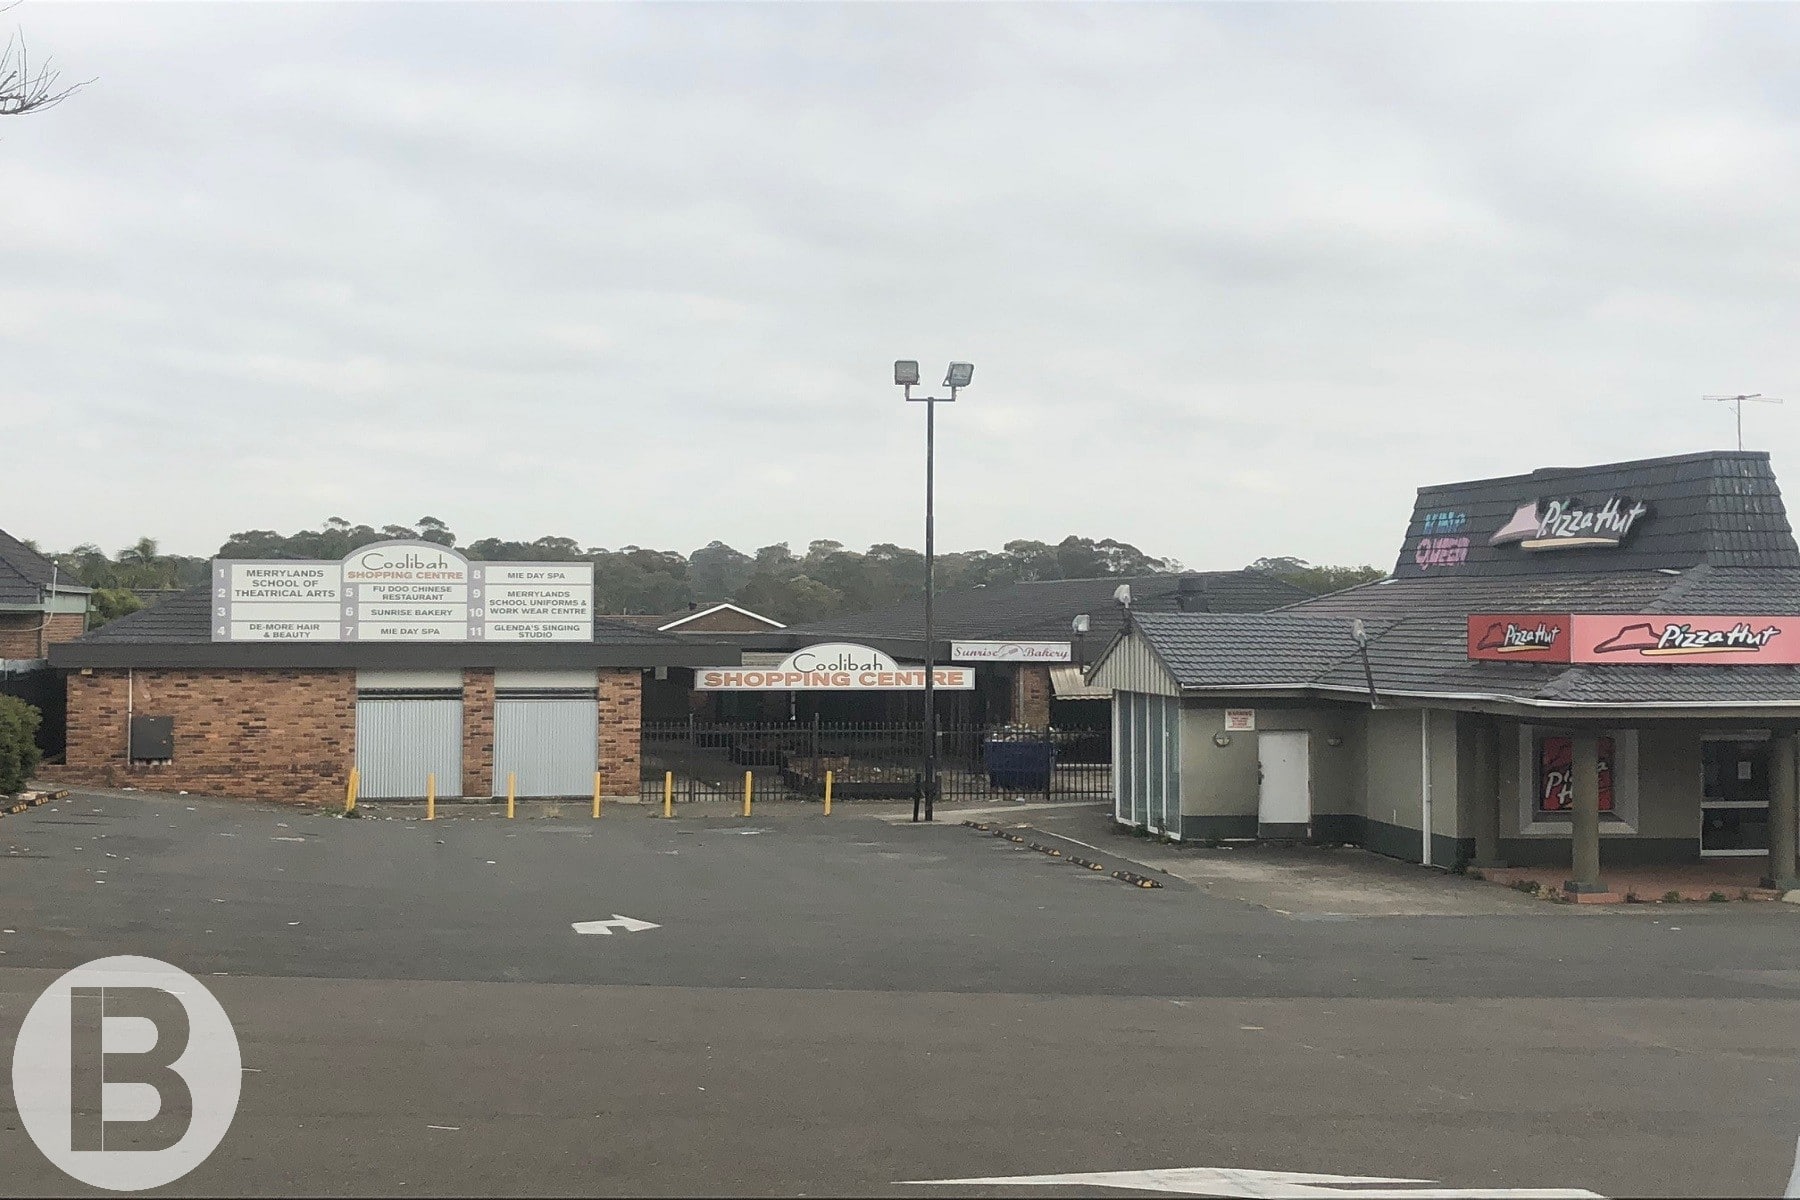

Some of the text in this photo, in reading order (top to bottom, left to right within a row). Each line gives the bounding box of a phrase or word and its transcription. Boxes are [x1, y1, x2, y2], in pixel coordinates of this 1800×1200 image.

[1536, 498, 1646, 539] Pizza Hut
[362, 552, 448, 571] Coolibah
[219, 568, 225, 578] 1
[246, 569, 324, 578] MERRYLANDS
[347, 571, 464, 580] SHOPPING CENTRE
[473, 570, 481, 579] 8
[252, 580, 319, 588] SCHOOL OF
[372, 585, 453, 593] FU DOO CHINESE
[217, 588, 226, 598] 2
[234, 589, 336, 598] THEATRICAL ARTS
[345, 587, 354, 597] 5
[382, 593, 445, 601] RESTAURANT
[473, 589, 481, 598] 9
[217, 607, 226, 617] 3
[345, 606, 354, 617] 6
[370, 609, 454, 617] SUNRISE BAKERY
[469, 608, 484, 618] 10
[217, 626, 226, 636] 4
[345, 626, 354, 636] 7
[469, 627, 482, 637] 11
[1503, 622, 1561, 647] Pizza Hut
[1657, 623, 1781, 649] Pizza Hut
[954, 647, 1069, 659] Sunrise Bakery
[793, 653, 883, 673] Coolibah
[704, 671, 965, 687] SHOPPING CENTRE
